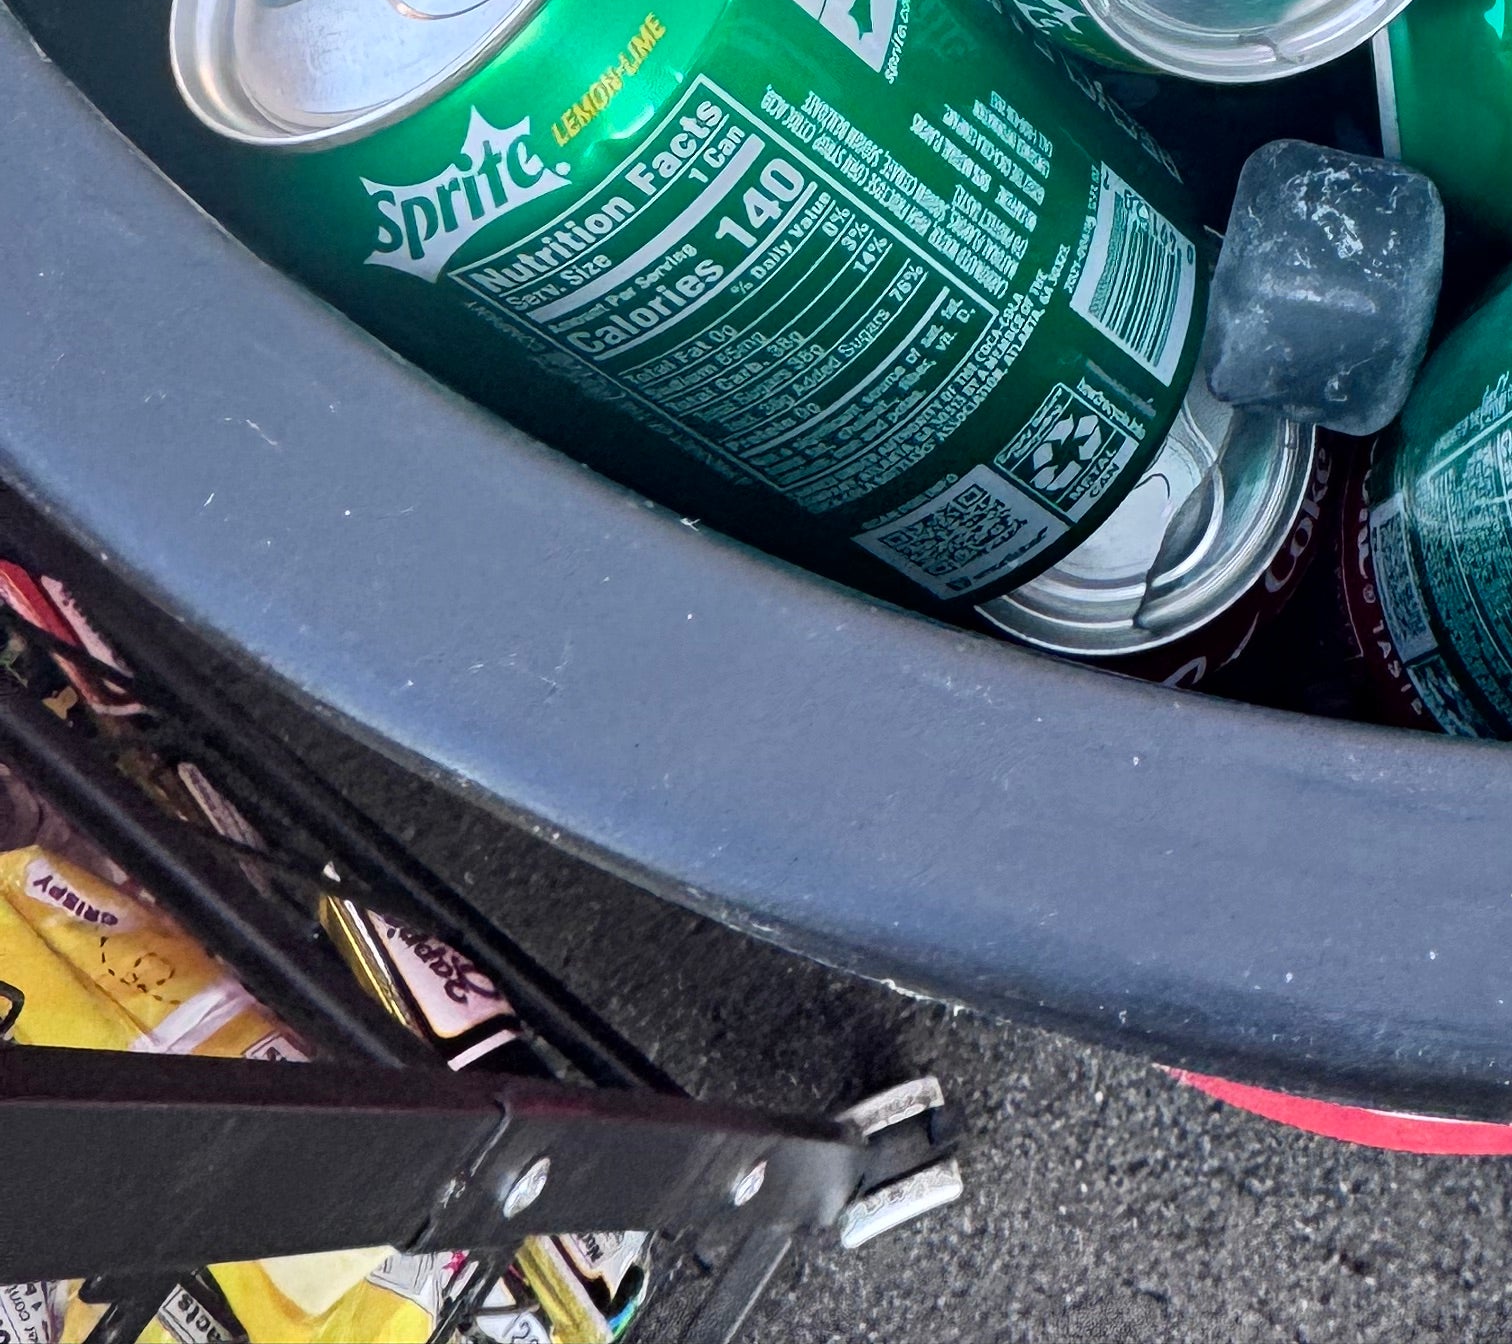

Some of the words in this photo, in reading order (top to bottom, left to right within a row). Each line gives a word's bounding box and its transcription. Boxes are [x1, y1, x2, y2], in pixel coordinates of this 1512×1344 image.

[551, 11, 668, 149] LEMON-LIME
[373, 128, 551, 263] Sprite
[469, 195, 637, 294] Nutrition
[624, 100, 723, 197] Facts
[506, 284, 568, 311] Serv.
[560, 253, 613, 287] Size
[688, 167, 709, 183] 1
[703, 124, 746, 169] Can
[750, 238, 794, 281] Daily
[787, 191, 832, 240] Value
[820, 206, 852, 238] 0%
[840, 219, 871, 252] 3%
[566, 258, 725, 354] Calories
[714, 157, 805, 249] 140
[852, 235, 889, 274] 14%
[888, 264, 926, 303] 76%
[1088, 464, 1120, 500] CAN
